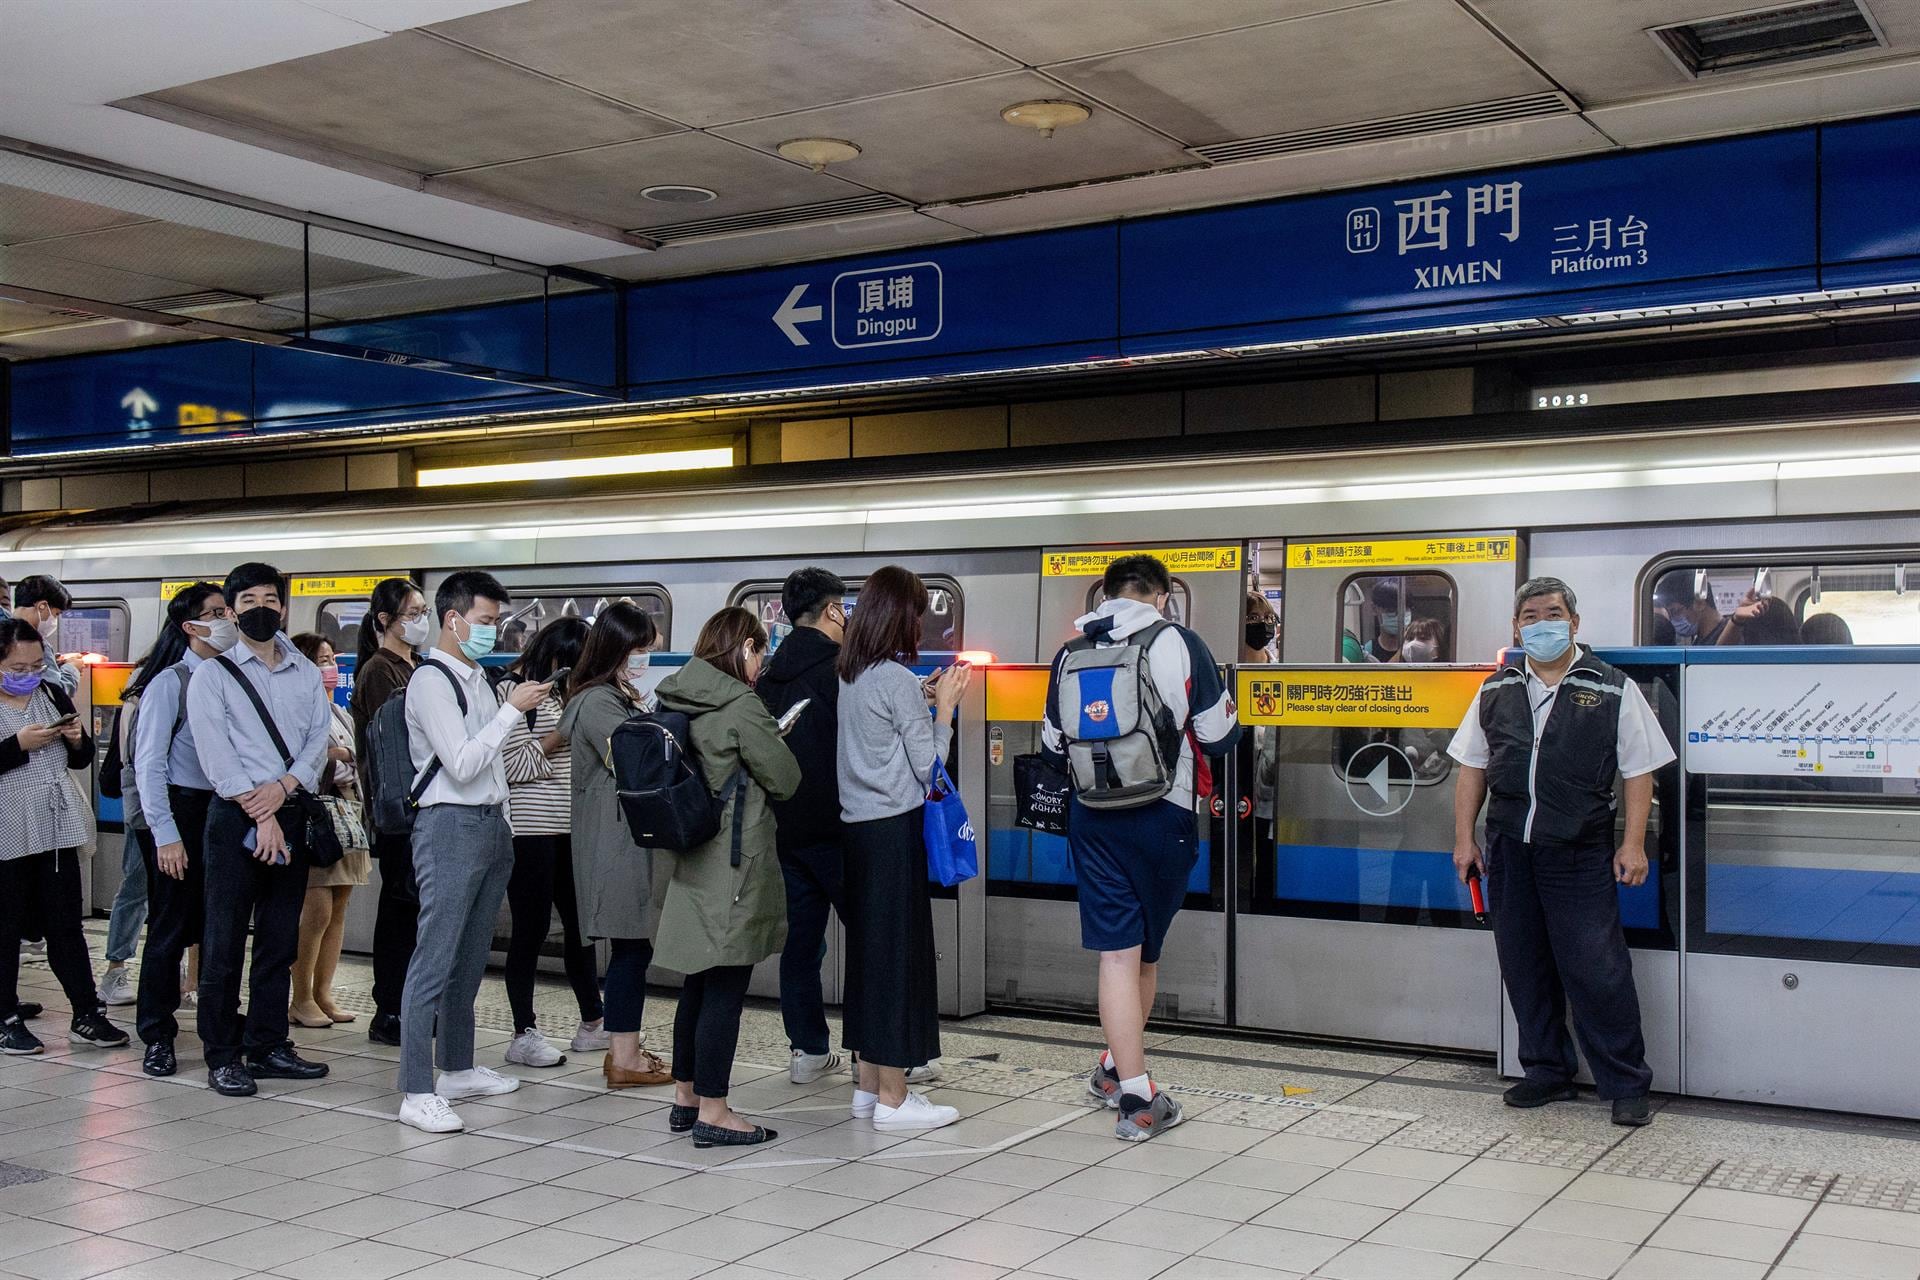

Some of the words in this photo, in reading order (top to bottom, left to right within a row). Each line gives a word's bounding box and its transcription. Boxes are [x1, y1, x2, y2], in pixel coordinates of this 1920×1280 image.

[1353, 214, 1373, 230] BL
[1394, 181, 1522, 255] 西門
[1354, 232, 1371, 247] 11
[1551, 215, 1648, 254] 三月台
[1551, 254, 1632, 274] Platform
[1637, 249, 1648, 265] 3
[1414, 259, 1501, 289] XIMEN
[858, 275, 914, 313] 頂埔
[856, 317, 917, 336] Dingpu
[1539, 393, 1588, 408] 2023
[1162, 551, 1215, 563] 小心月台間隙
[1316, 545, 1372, 557] 照顧隨行孩童
[1426, 542, 1485, 554] 先下車後上車
[1286, 684, 1412, 702] 關門時勿強行進出
[1286, 703, 1314, 713] Please
[1316, 703, 1333, 713] stay
[1335, 703, 1356, 712] clear
[1358, 703, 1367, 712] of
[1369, 704, 1401, 715] closing
[1403, 705, 1430, 714] doors
[1168, 1084, 1255, 1100] Waiting
[1265, 1096, 1316, 1108] Line
